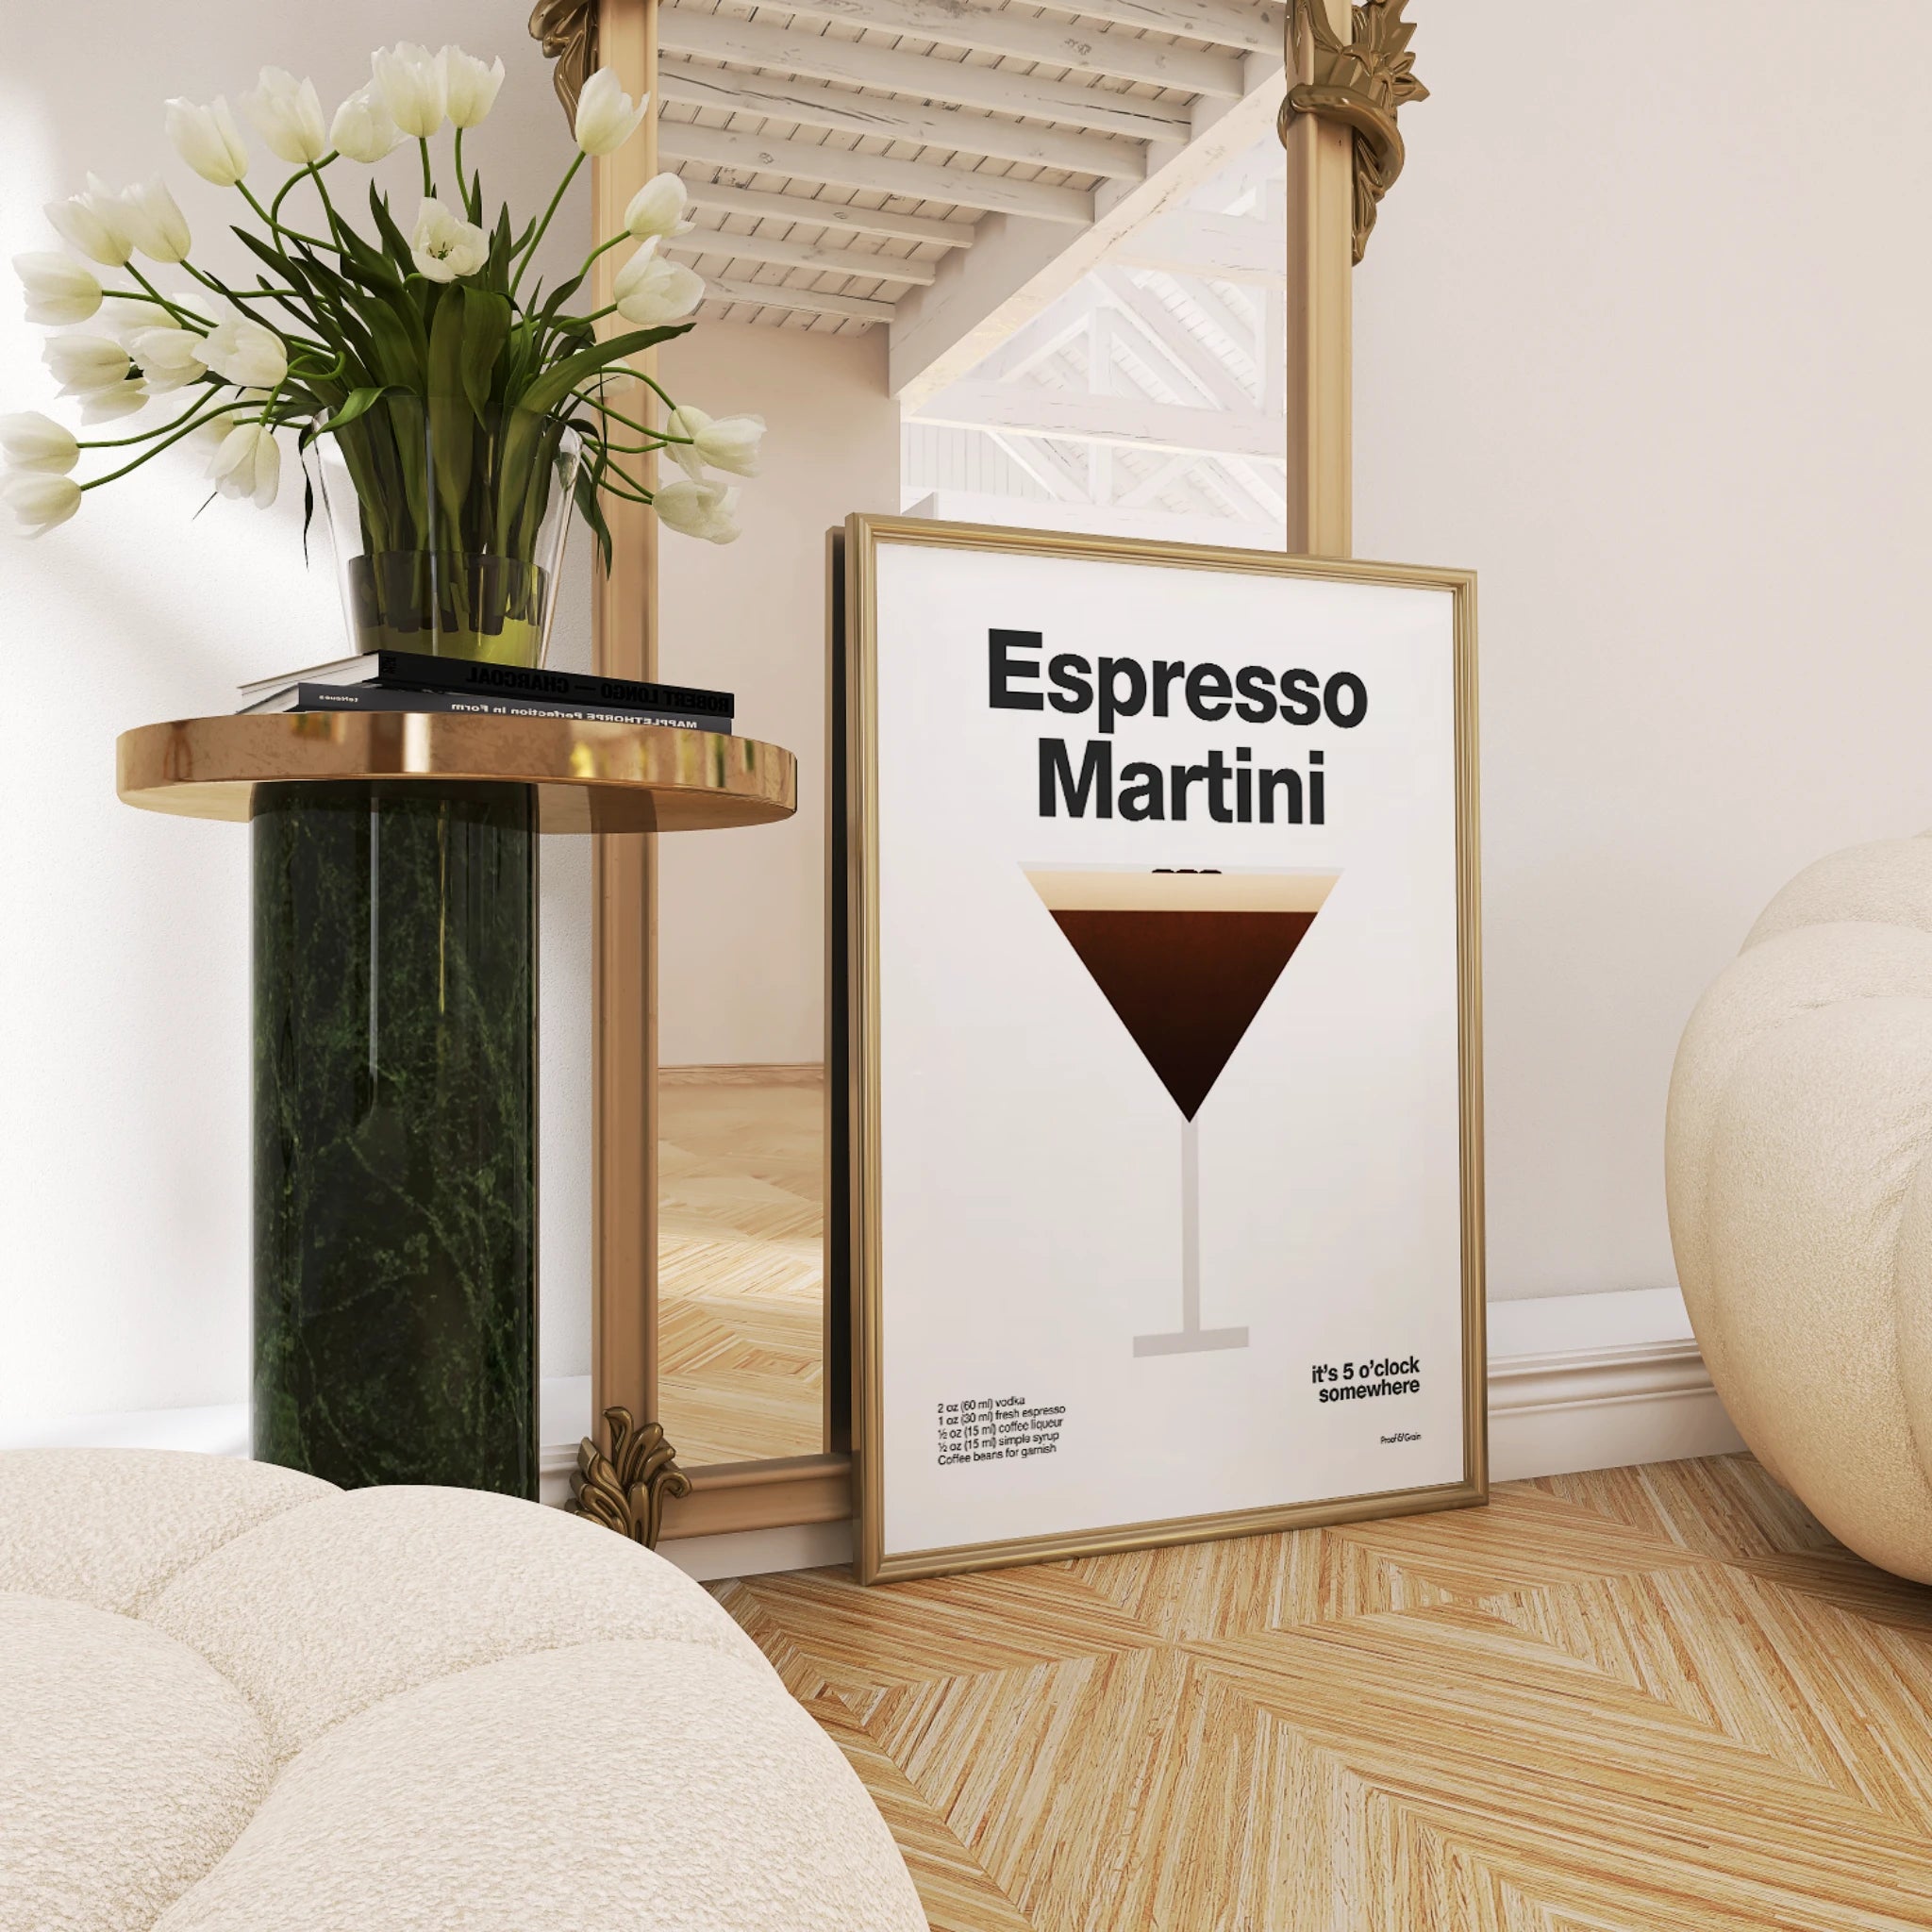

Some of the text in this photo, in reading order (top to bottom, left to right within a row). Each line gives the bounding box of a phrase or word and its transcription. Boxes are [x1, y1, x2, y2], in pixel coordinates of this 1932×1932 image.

[988, 628, 1368, 734] Espresso
[1039, 737, 1325, 825] Martini
[1342, 1362, 1355, 1380] 5
[1319, 1378, 1421, 1403] somewhere
[938, 1396, 1025, 1413] 2 oz (60 ml) vodka
[939, 1406, 1066, 1425] 1 oz (30 ml) fresh espresso
[949, 1428, 962, 1439] oz
[964, 1425, 979, 1439] (15
[982, 1424, 996, 1436] ml)
[998, 1420, 1029, 1433] coffee
[1030, 1418, 1063, 1431] liqueur
[949, 1441, 962, 1452] oz
[964, 1439, 979, 1452] (15
[982, 1437, 996, 1449] ml)
[998, 1433, 1031, 1446] simple
[1032, 1432, 1059, 1445] syrup
[938, 1443, 1058, 1466] Coffee beans for garnish
